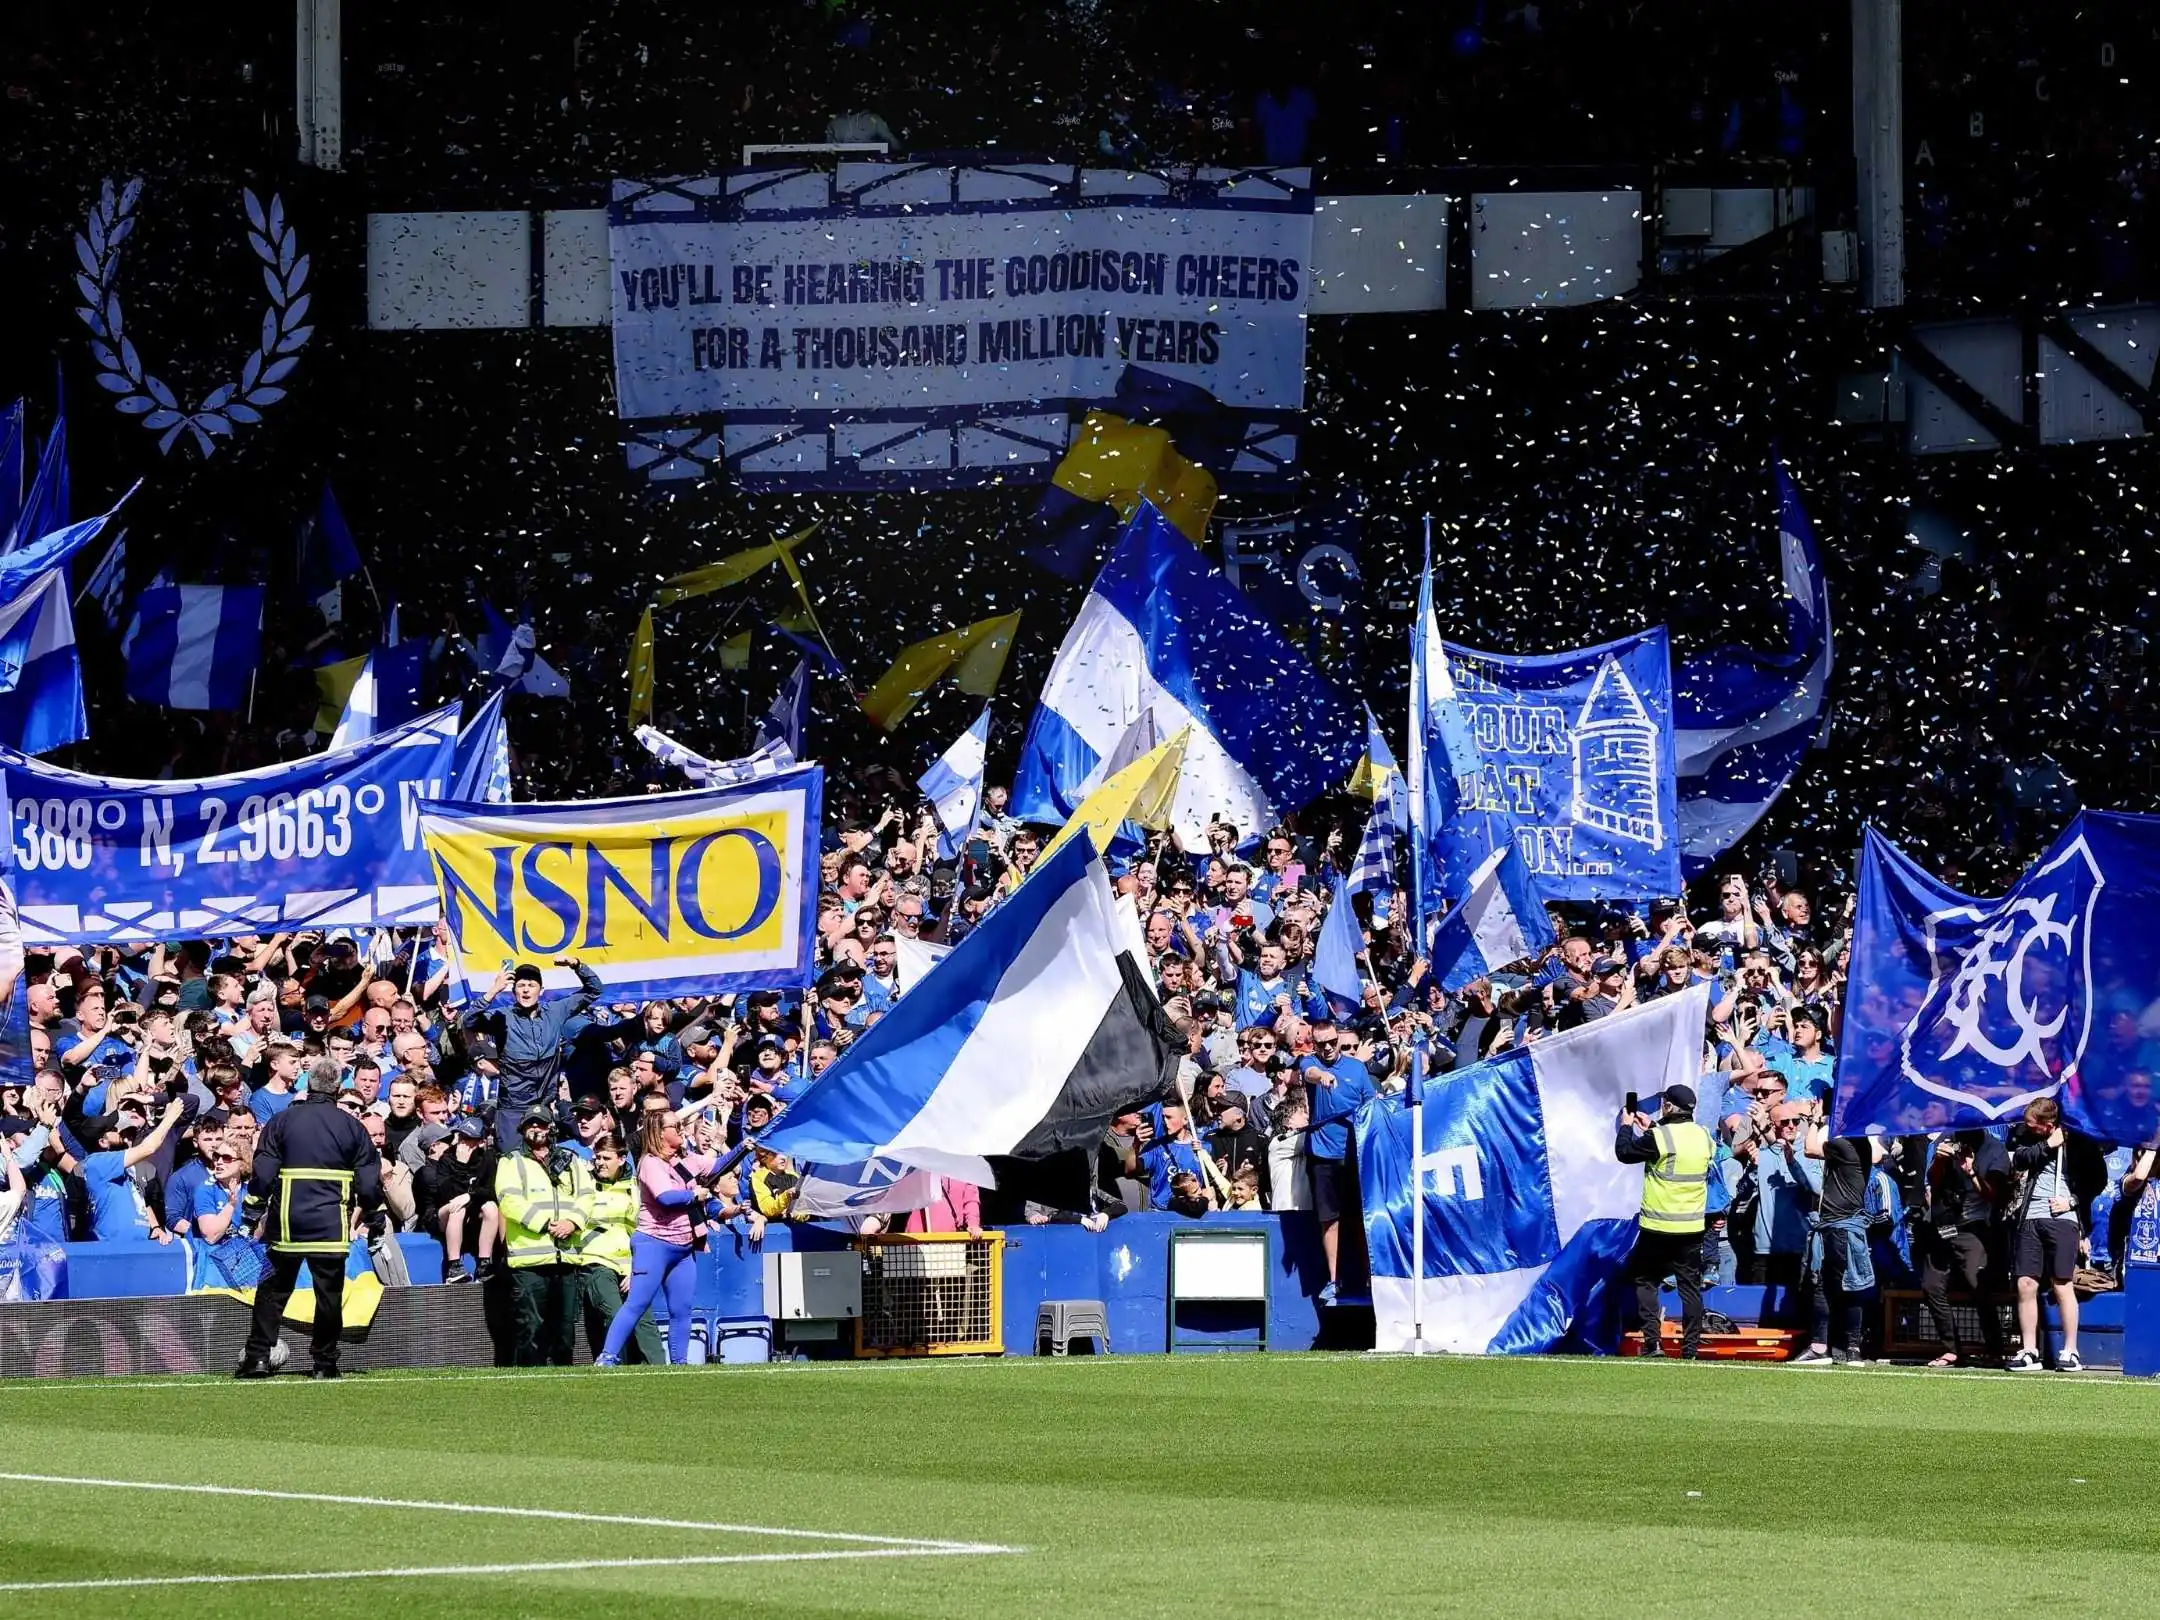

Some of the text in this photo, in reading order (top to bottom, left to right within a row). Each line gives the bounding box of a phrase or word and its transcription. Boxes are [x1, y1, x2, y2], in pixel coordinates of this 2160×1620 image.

[1914, 139, 1937, 168] A
[621, 250, 1299, 312] YOU'LL BE HEARING THE GOODISON CHEERS
[692, 314, 1220, 372] FOR A THOUSAND MILLION YEARS
[140, 798, 184, 877] N,
[197, 784, 385, 863] 2.9663°
[434, 828, 782, 956] NSNO
